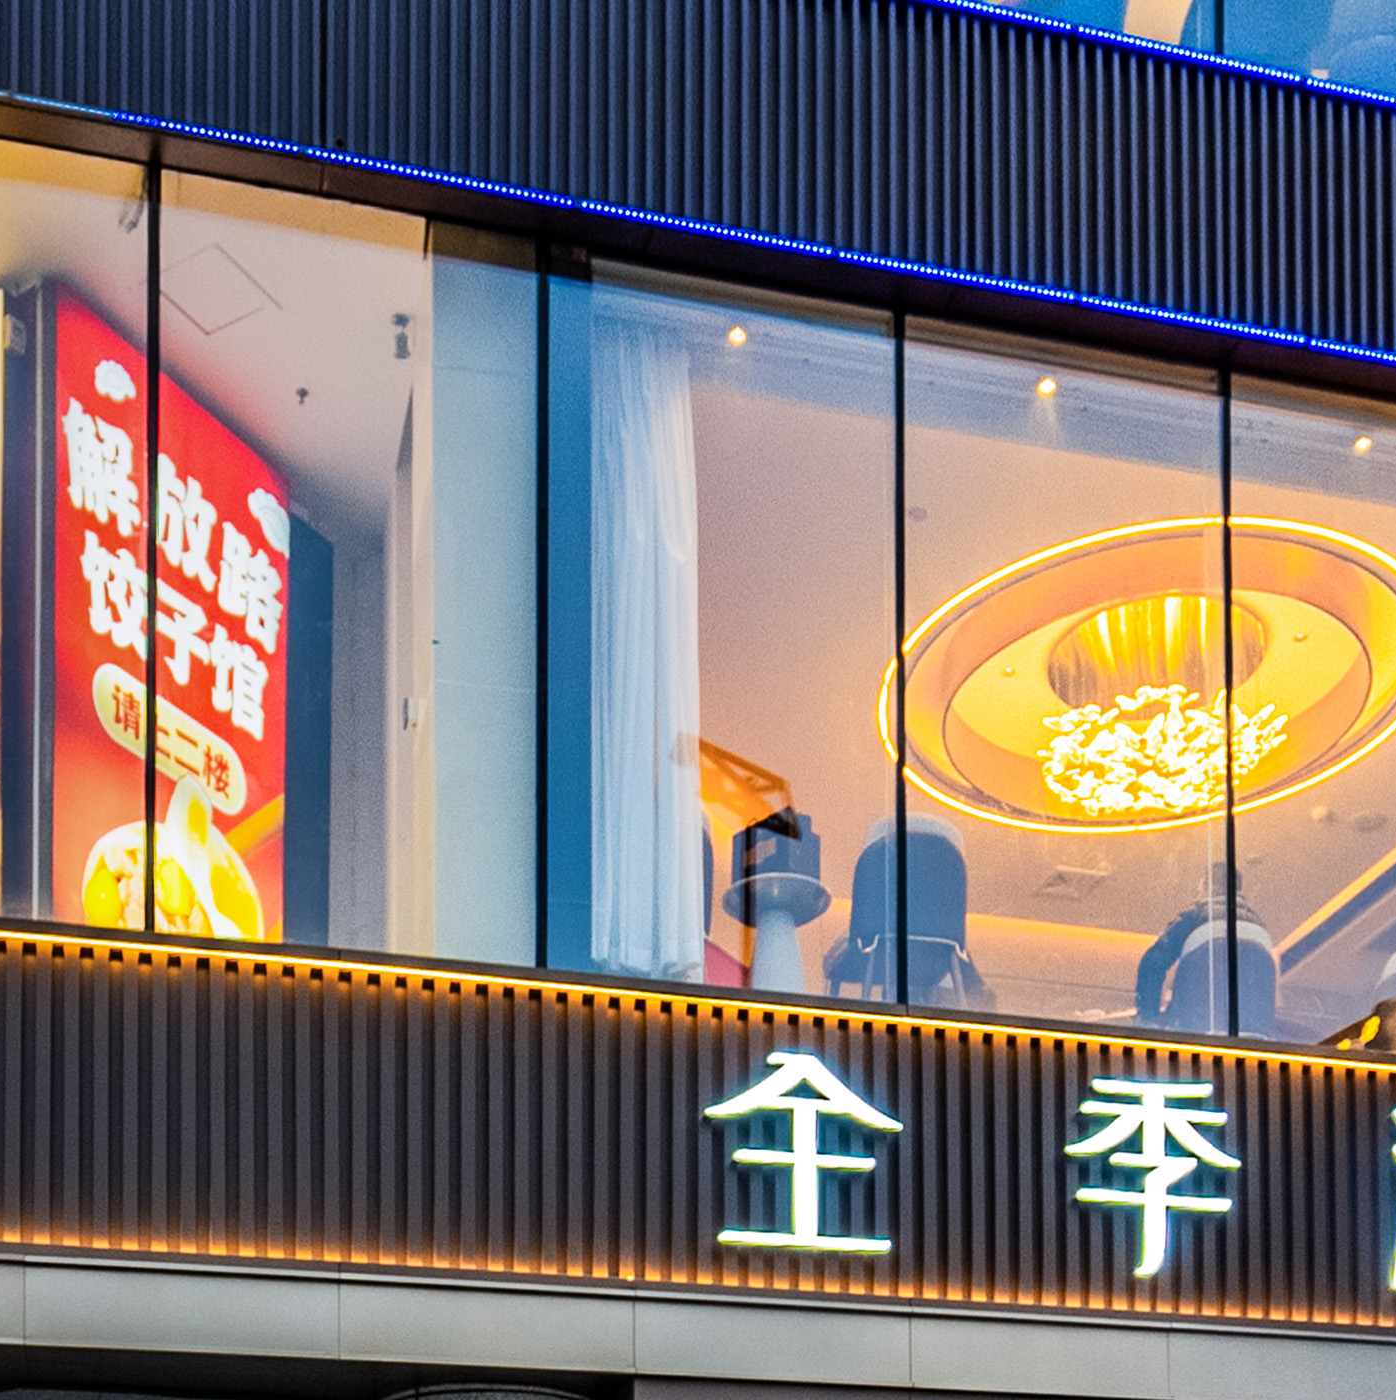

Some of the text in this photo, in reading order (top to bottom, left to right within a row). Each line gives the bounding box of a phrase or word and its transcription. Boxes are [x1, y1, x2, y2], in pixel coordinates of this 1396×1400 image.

[63, 397, 283, 654] 解放路
[81, 529, 270, 742] 饺子馆
